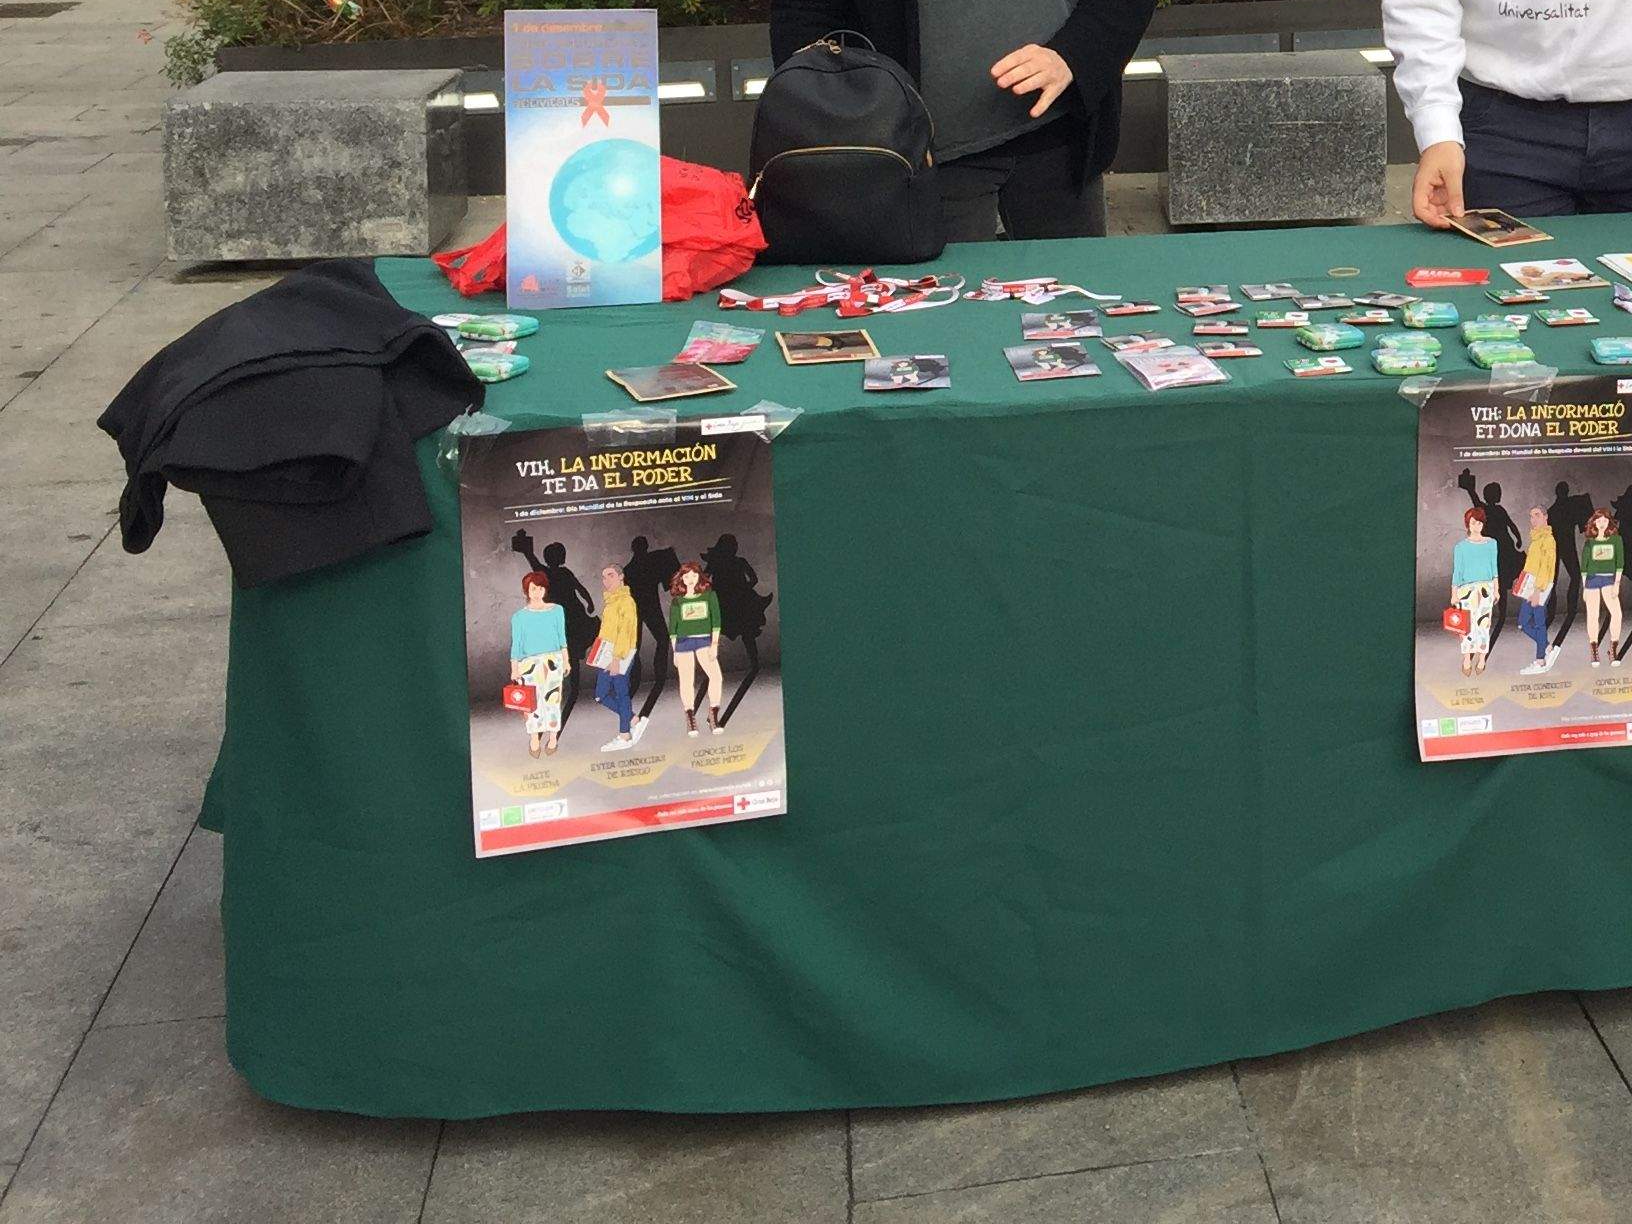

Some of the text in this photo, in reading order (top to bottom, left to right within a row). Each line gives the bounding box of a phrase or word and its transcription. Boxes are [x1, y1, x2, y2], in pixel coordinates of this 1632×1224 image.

[1498, 1, 1590, 21] Universalitat
[513, 73, 651, 91] LA SIDA
[1471, 400, 1626, 421] VIH: LA INFORMACIÓ
[1475, 420, 1619, 439] ET DONA EL PODER
[560, 456, 586, 473] LA
[589, 442, 717, 471] INFORMACIÓN
[541, 466, 693, 495] TE DA EL PODER
